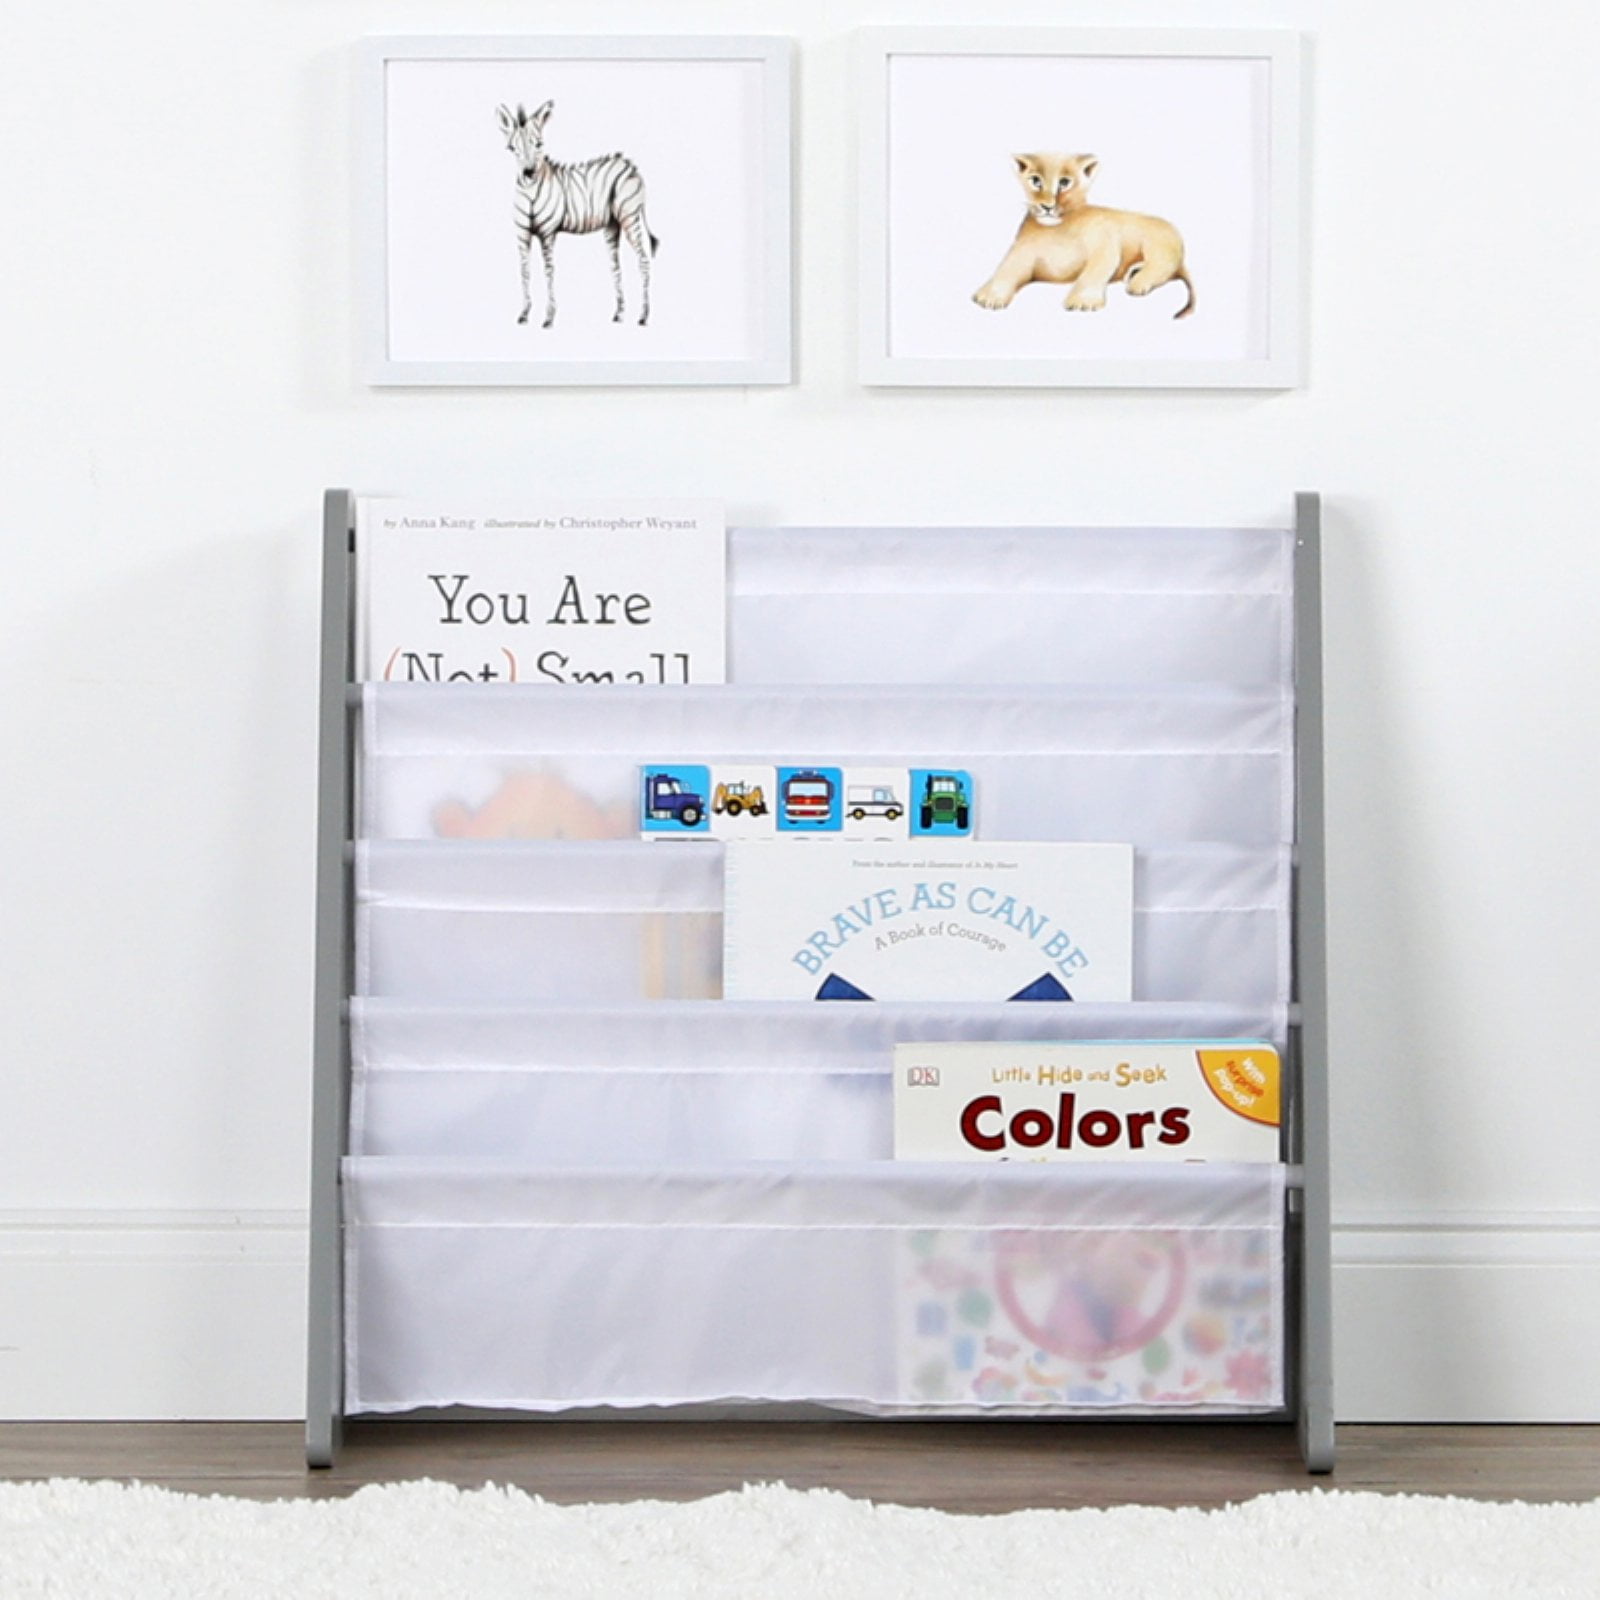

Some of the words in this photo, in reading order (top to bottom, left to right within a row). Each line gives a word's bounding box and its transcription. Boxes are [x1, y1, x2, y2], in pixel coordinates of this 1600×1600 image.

[383, 518, 397, 530] by
[399, 518, 436, 529] Anna
[439, 517, 475, 531] Kang
[484, 518, 540, 529] illustrated
[543, 518, 556, 531] by
[559, 516, 642, 531] Christopher
[645, 517, 697, 531] Weyant
[428, 575, 530, 625] You
[547, 575, 652, 625] Are
[792, 888, 903, 975] BRAVE
[910, 882, 957, 911] AS
[967, 887, 1049, 939] CAN
[1041, 930, 1090, 978] BE
[874, 936, 888, 952] A
[888, 923, 925, 945] Book
[928, 922, 944, 937] of
[947, 923, 1007, 952] Courage
[992, 1065, 1031, 1084] Little
[1038, 1064, 1083, 1086] Hide
[1087, 1069, 1111, 1082] and
[1114, 1062, 1168, 1087] Seek
[959, 1092, 1191, 1152] Colors
